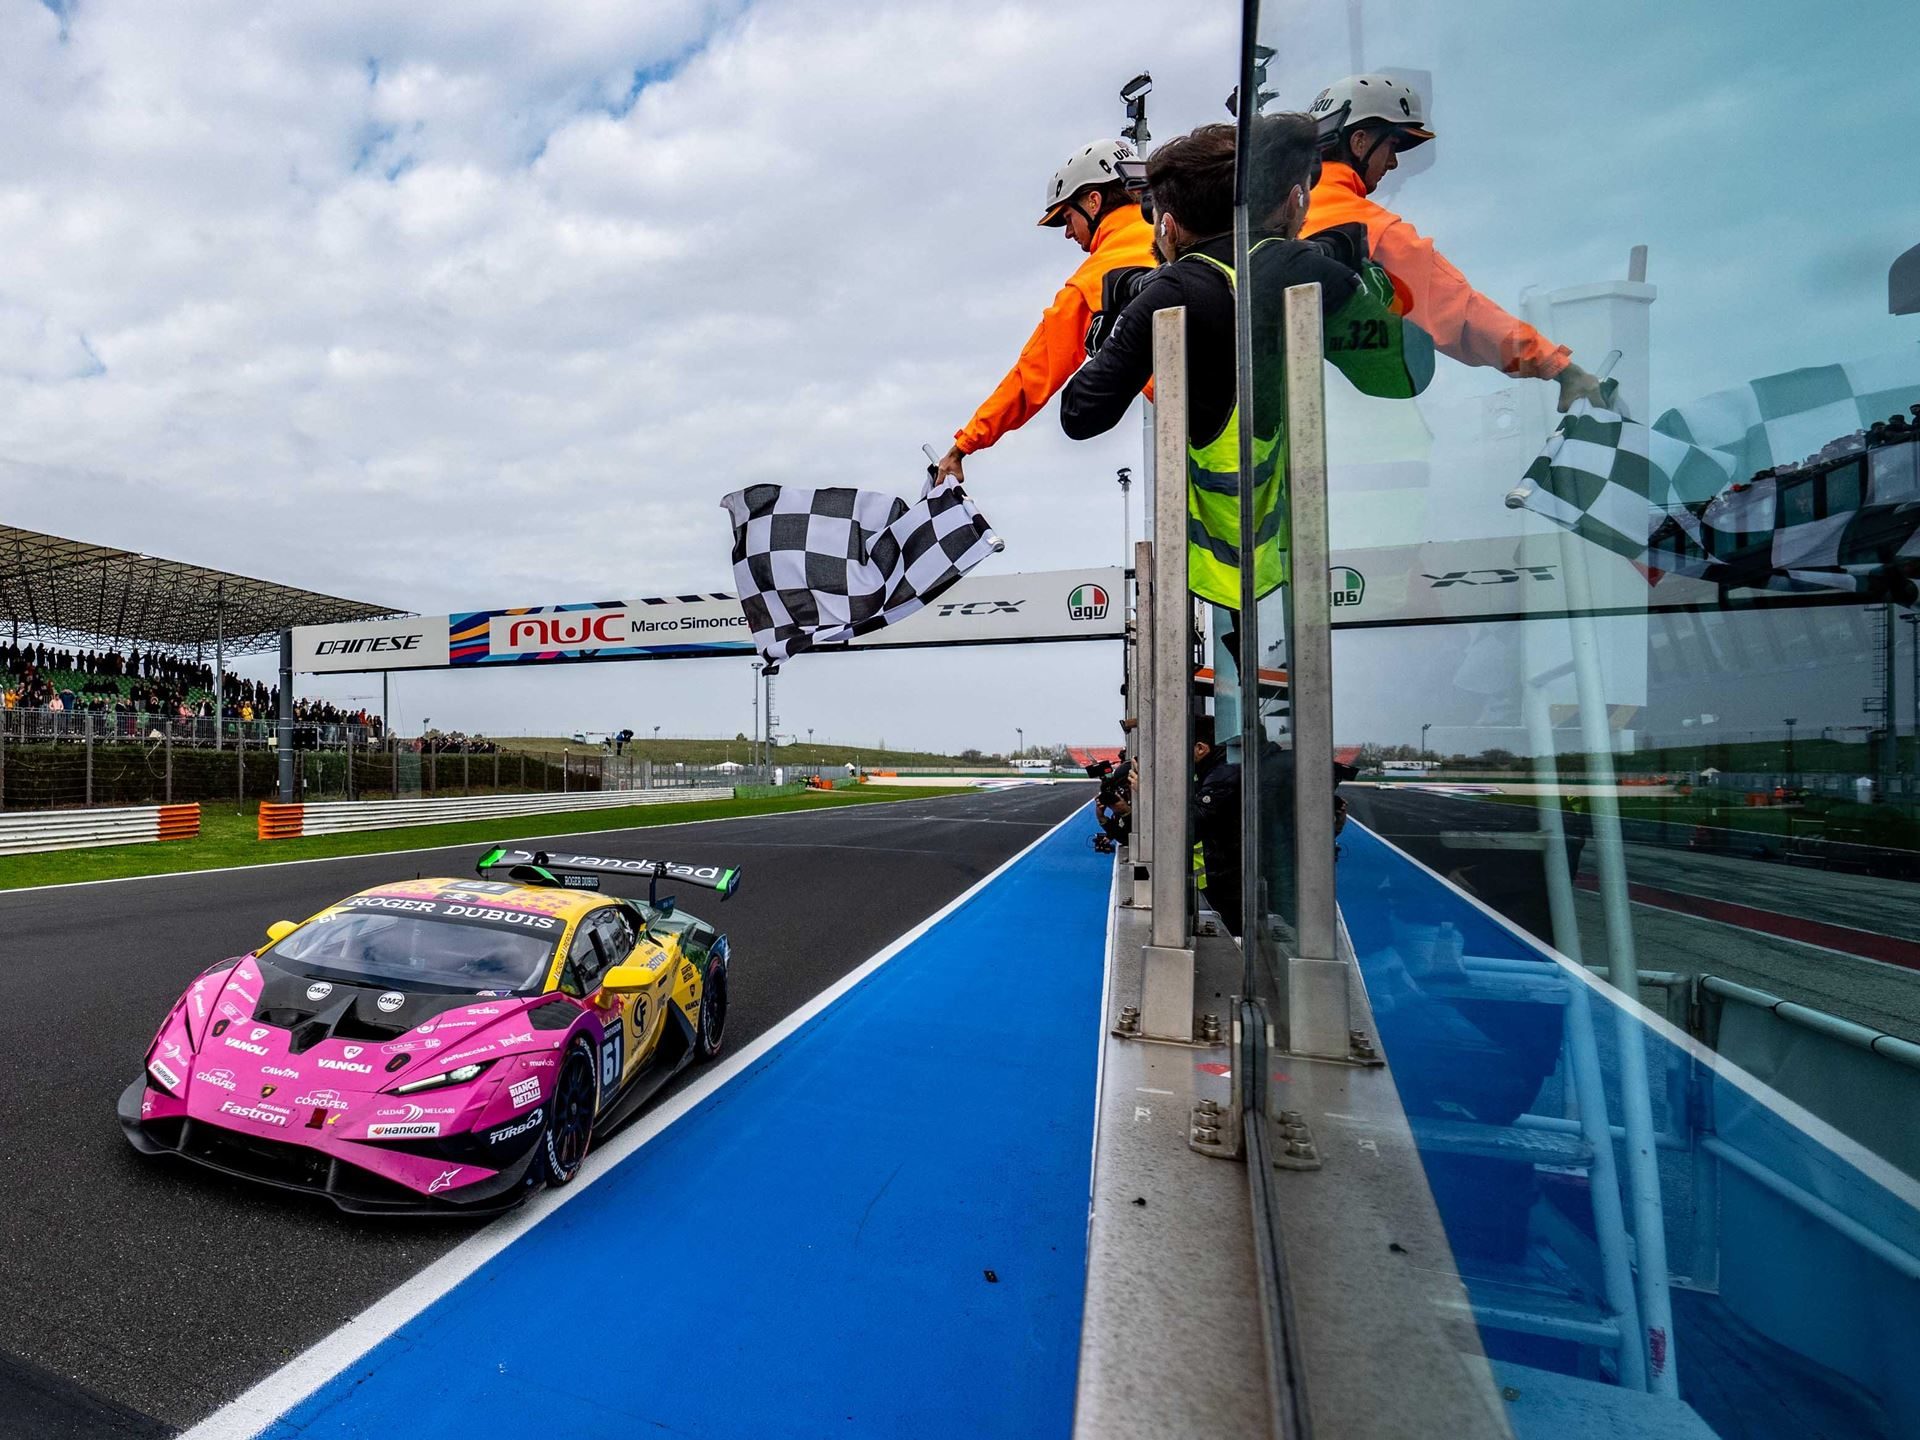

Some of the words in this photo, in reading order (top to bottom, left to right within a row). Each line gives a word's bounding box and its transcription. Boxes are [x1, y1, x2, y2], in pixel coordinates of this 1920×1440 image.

[937, 600, 1026, 617] TCX
[1073, 604, 1104, 620] agv
[631, 619, 678, 633] Marco
[680, 616, 748, 630] Simonce
[315, 634, 424, 656] DAINESE
[347, 897, 437, 913] ROGER
[443, 904, 556, 929] DUBUIS
[224, 1037, 269, 1056] VANOLI
[318, 1058, 373, 1074] VANOLI
[602, 1035, 620, 1086] 61
[220, 1101, 287, 1126] Fastron
